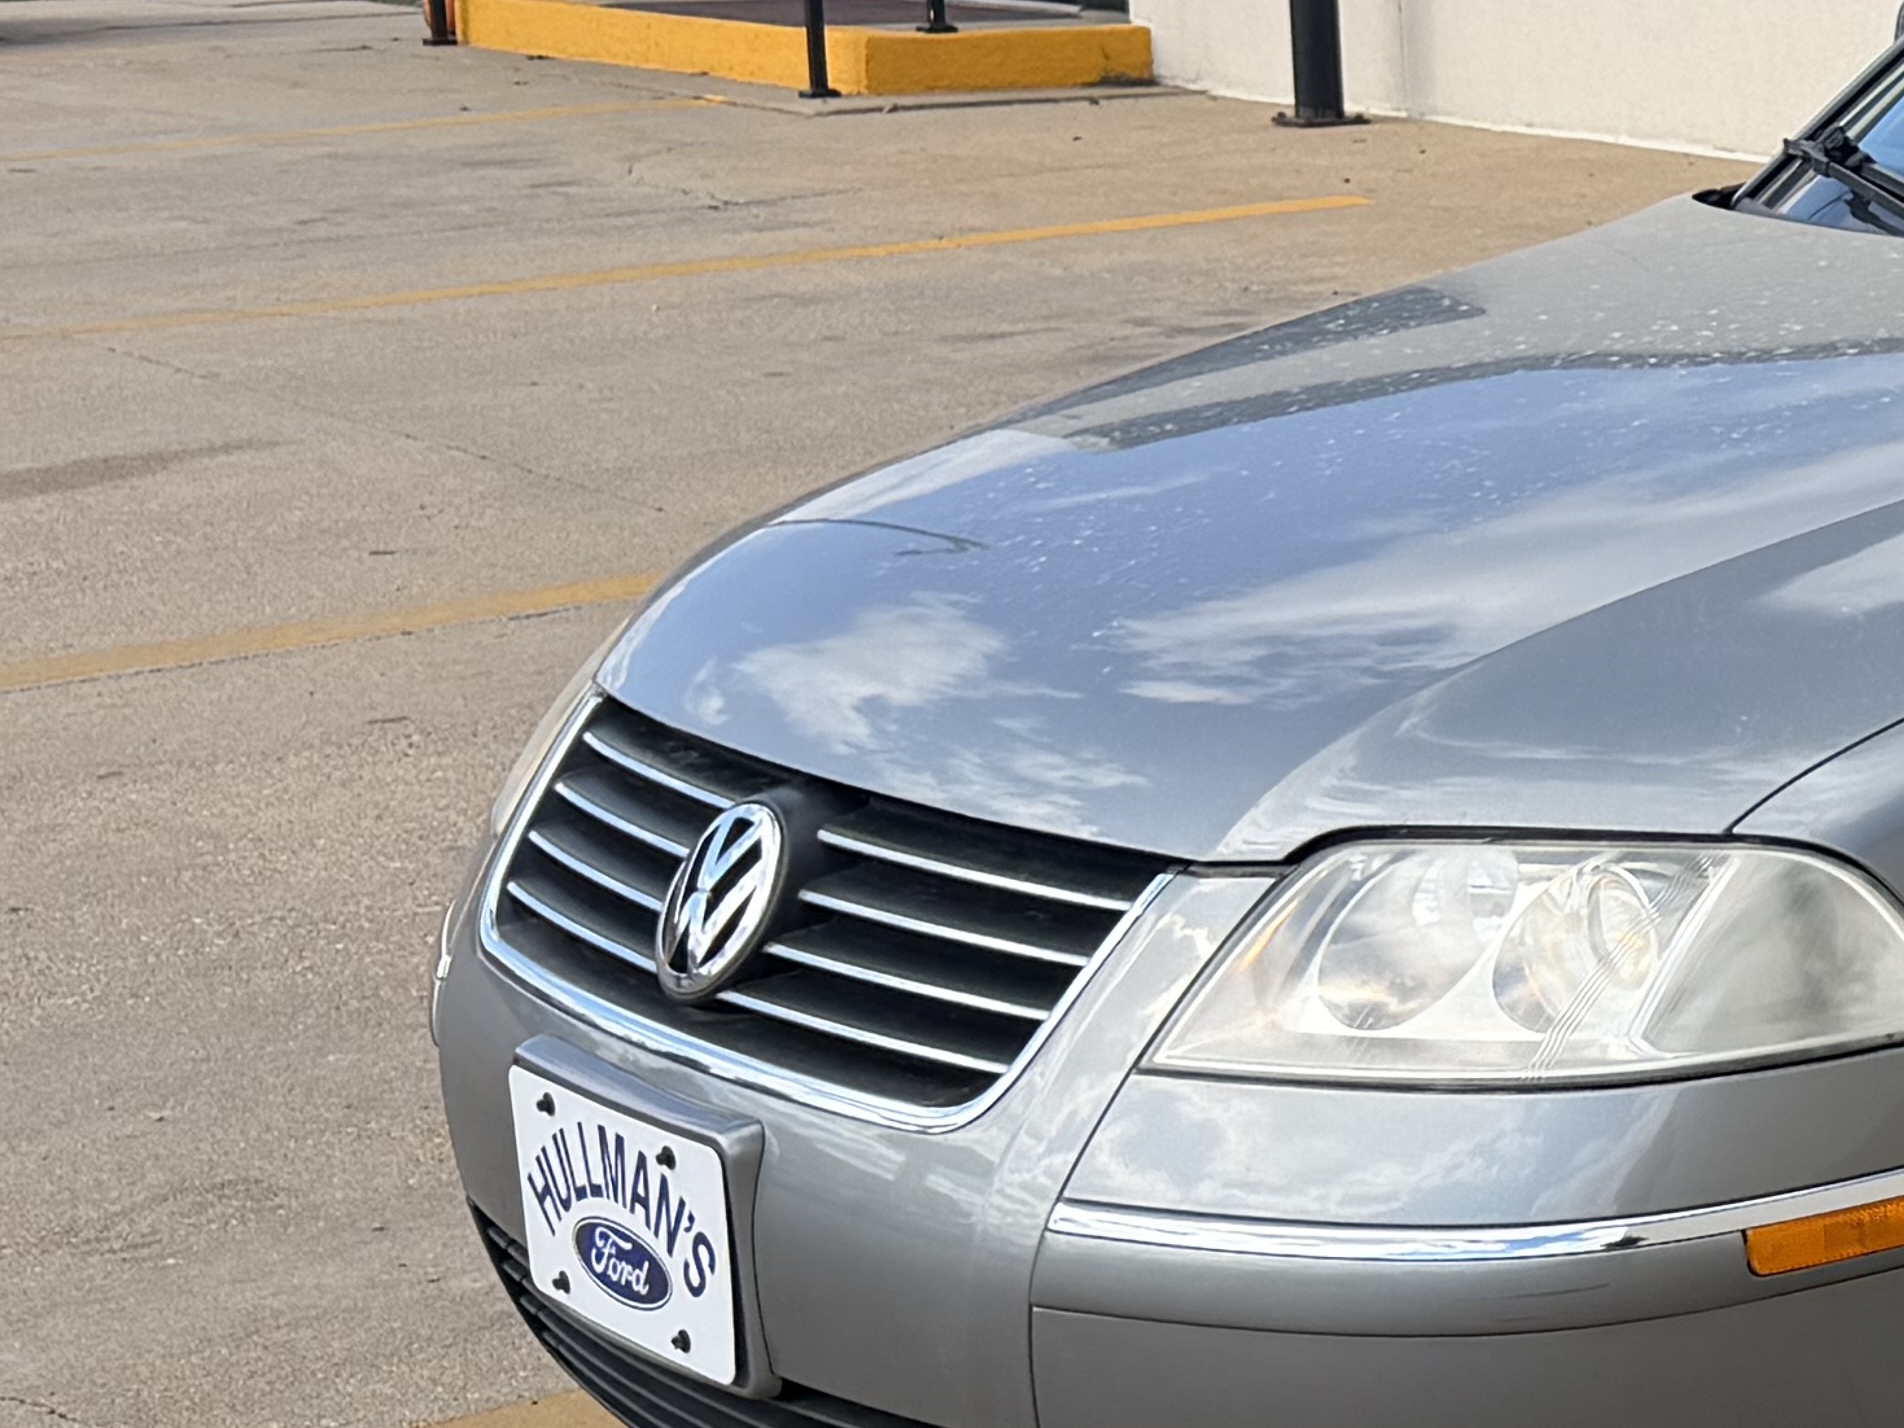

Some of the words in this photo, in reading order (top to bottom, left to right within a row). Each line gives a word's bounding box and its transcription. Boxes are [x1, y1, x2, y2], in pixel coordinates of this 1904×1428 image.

[661, 803, 783, 996] VW
[527, 1121, 717, 1299] HULLMAN'S
[590, 1226, 650, 1296] Ford
